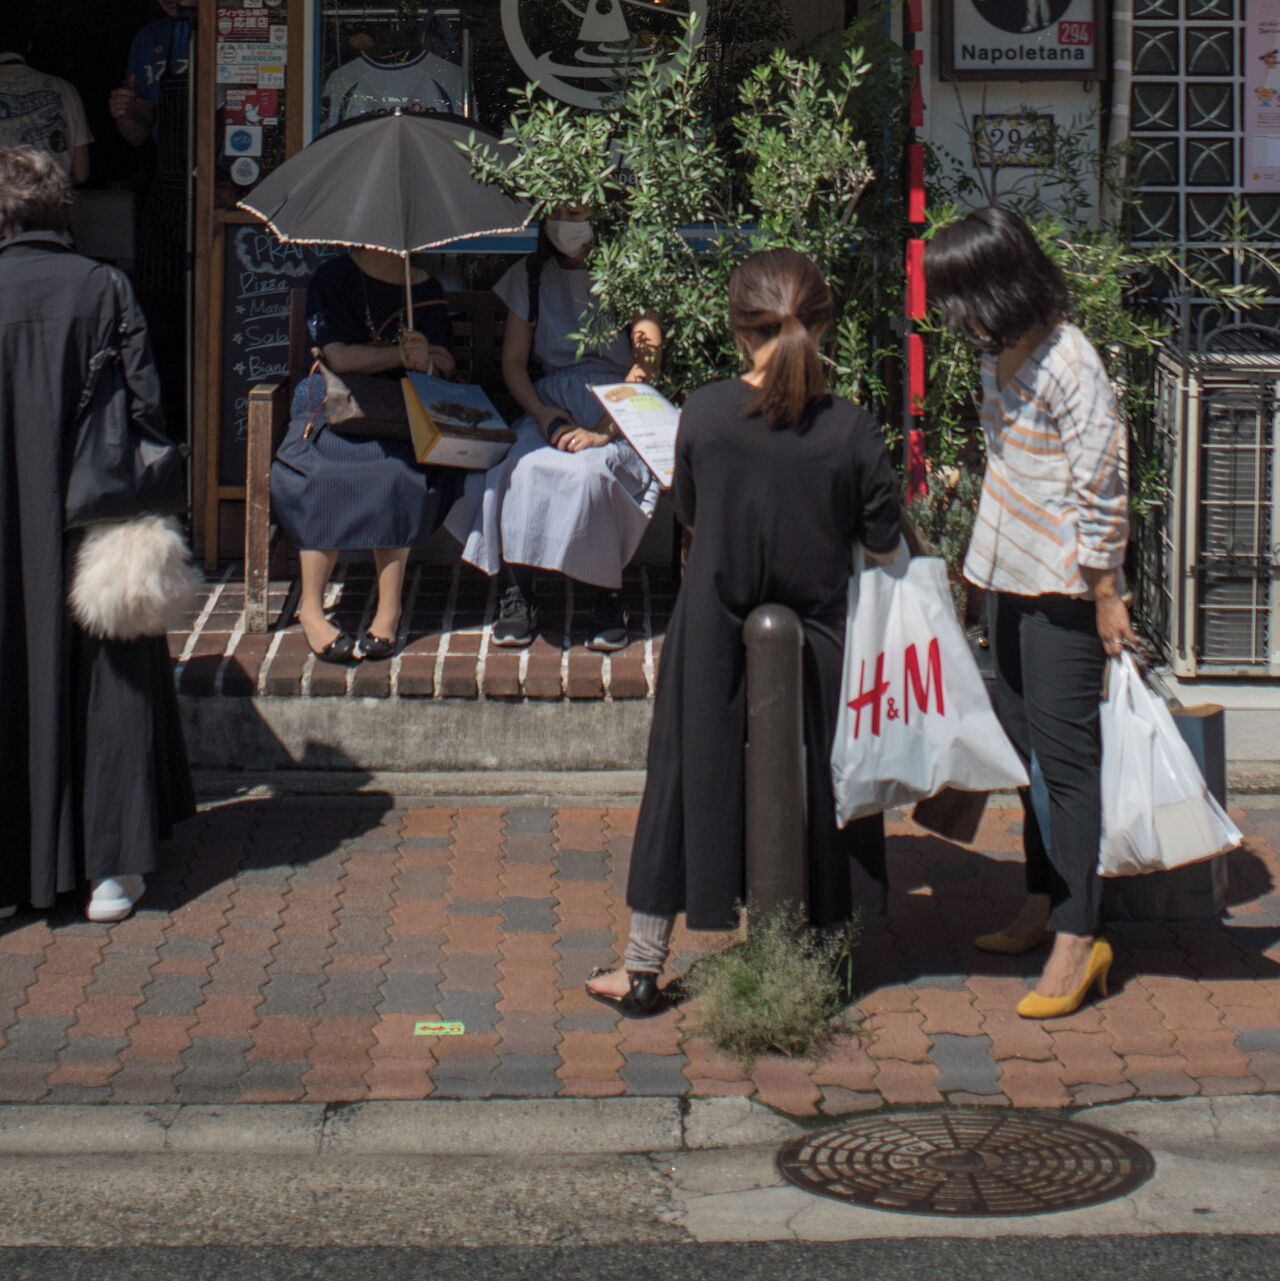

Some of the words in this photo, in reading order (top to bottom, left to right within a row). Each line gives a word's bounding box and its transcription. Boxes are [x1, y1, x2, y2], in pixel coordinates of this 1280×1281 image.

[1061, 23, 1089, 43] 294
[961, 44, 1085, 64] Napoletana
[239, 271, 289, 295] Pizza
[846, 636, 945, 740] H&M
